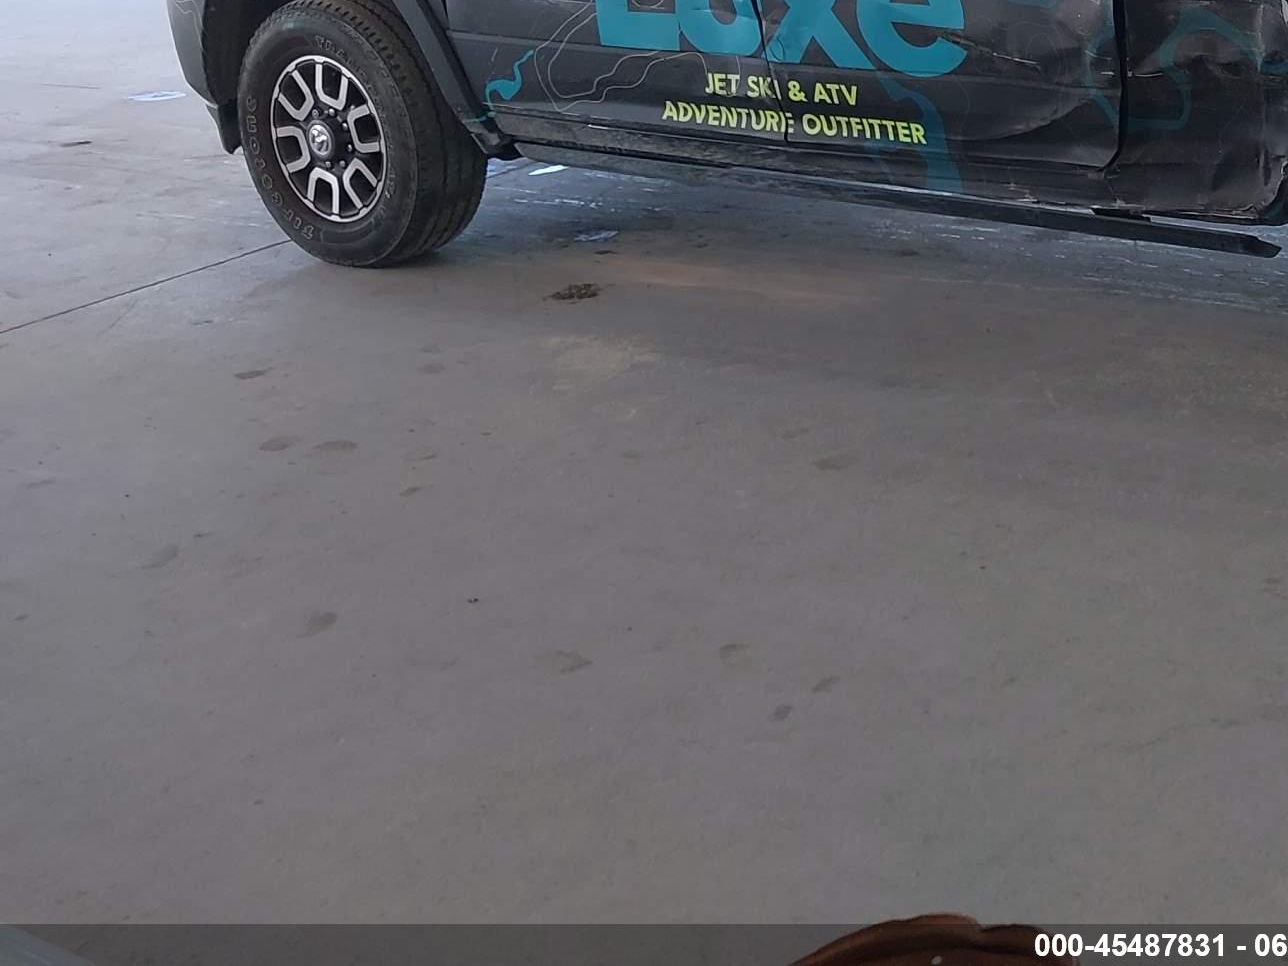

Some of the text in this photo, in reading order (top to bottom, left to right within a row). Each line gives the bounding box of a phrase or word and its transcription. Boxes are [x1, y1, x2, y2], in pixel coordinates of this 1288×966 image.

[705, 72, 858, 106] JET SKI & ATV
[661, 100, 928, 146] ADVENTURE OUTFITTER
